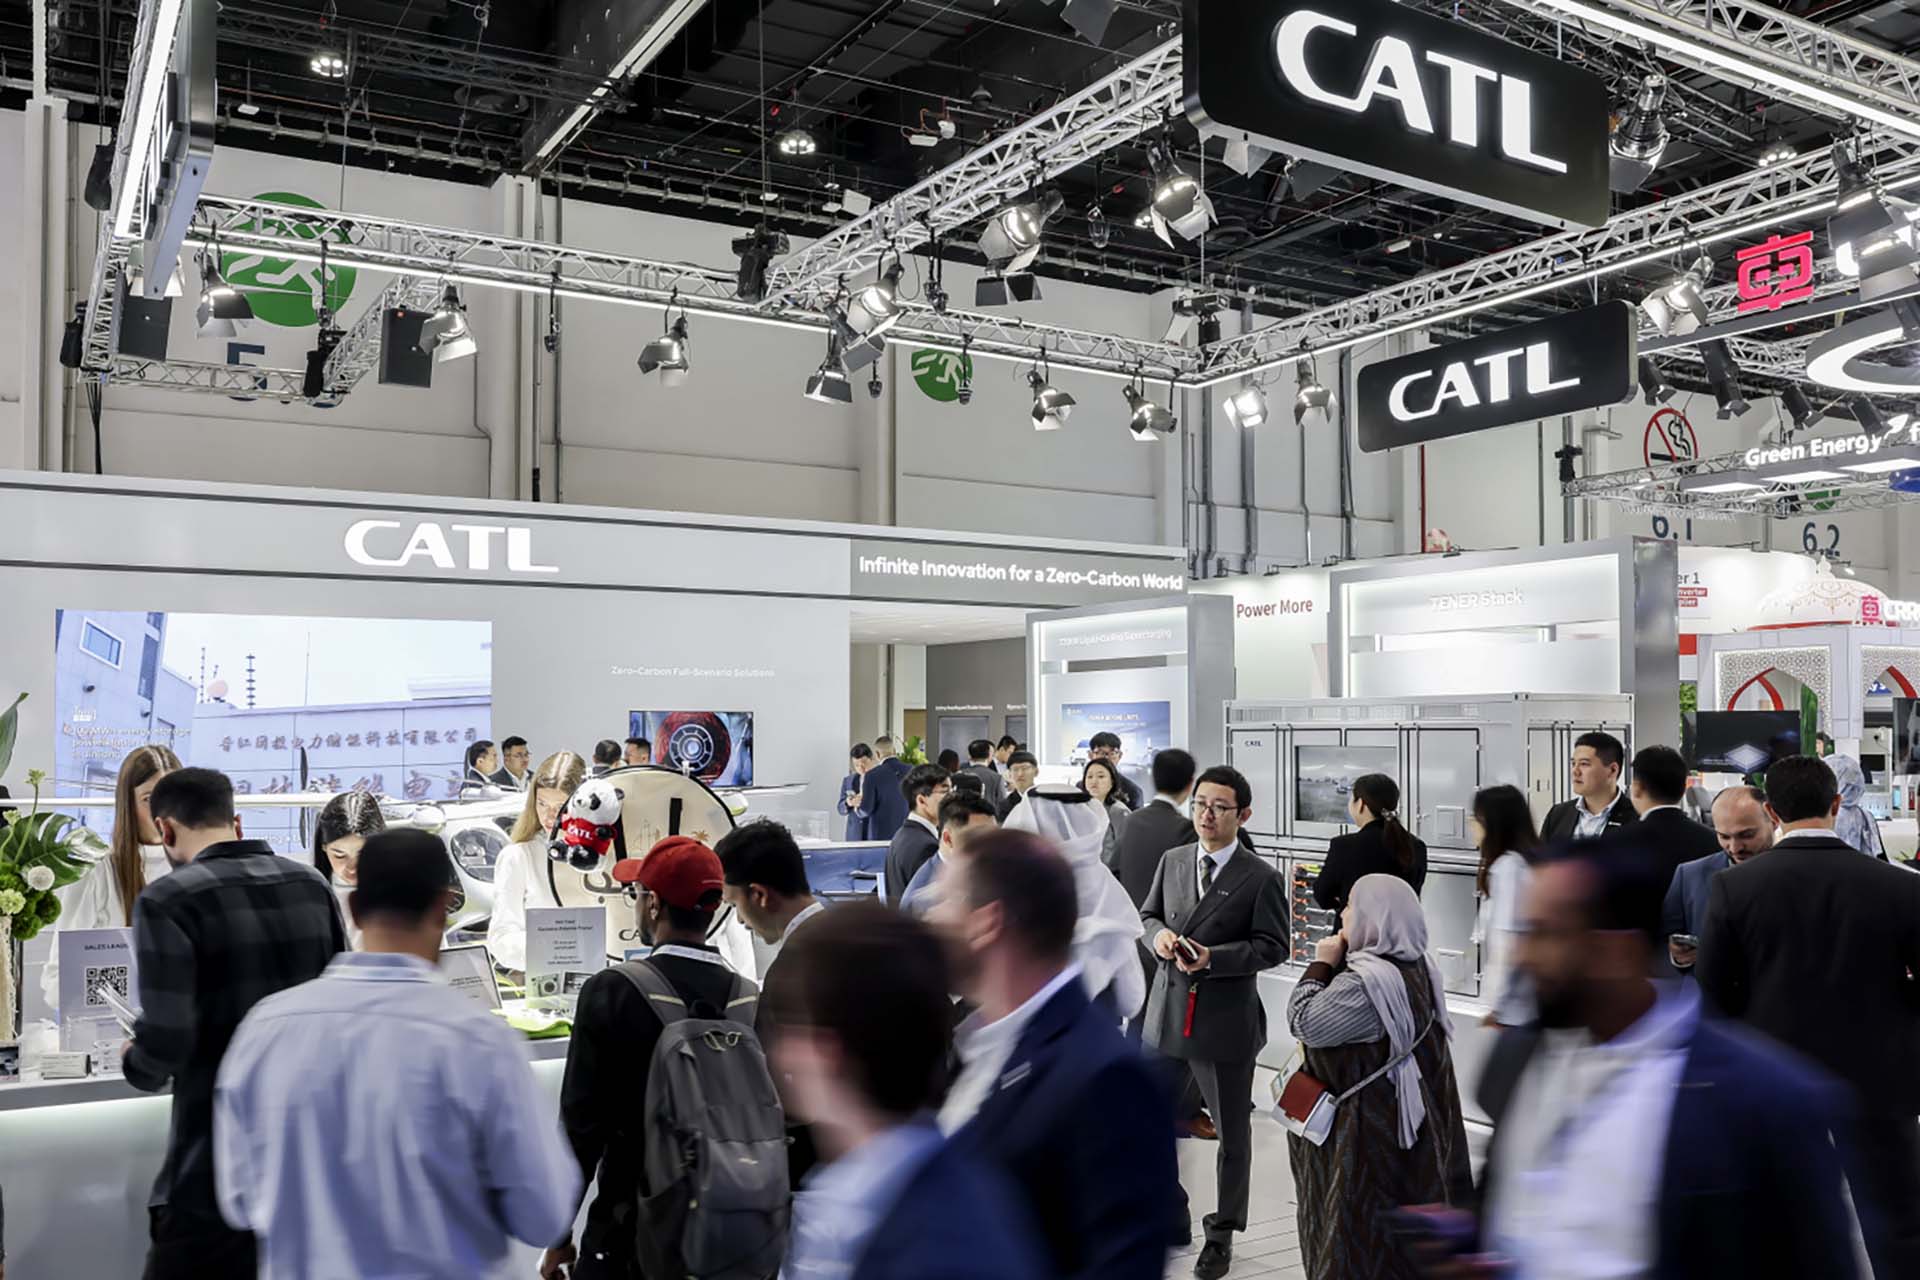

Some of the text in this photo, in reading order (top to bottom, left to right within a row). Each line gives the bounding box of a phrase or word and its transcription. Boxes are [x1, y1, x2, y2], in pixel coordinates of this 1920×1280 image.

[1276, 9, 1567, 174] CATL
[1389, 341, 1581, 422] CATL
[1745, 445, 1805, 466] Green
[1811, 434, 1882, 457] Energy
[1652, 515, 1692, 540] 6.1
[1803, 522, 1840, 559] 6.2
[344, 519, 559, 573] CATL
[859, 556, 1183, 591] Infinite Innovation for a Zero-Carbon World
[1236, 599, 1313, 619] Power More
[1480, 588, 1523, 608] Stack
[611, 666, 671, 676] Zero-Carbon
